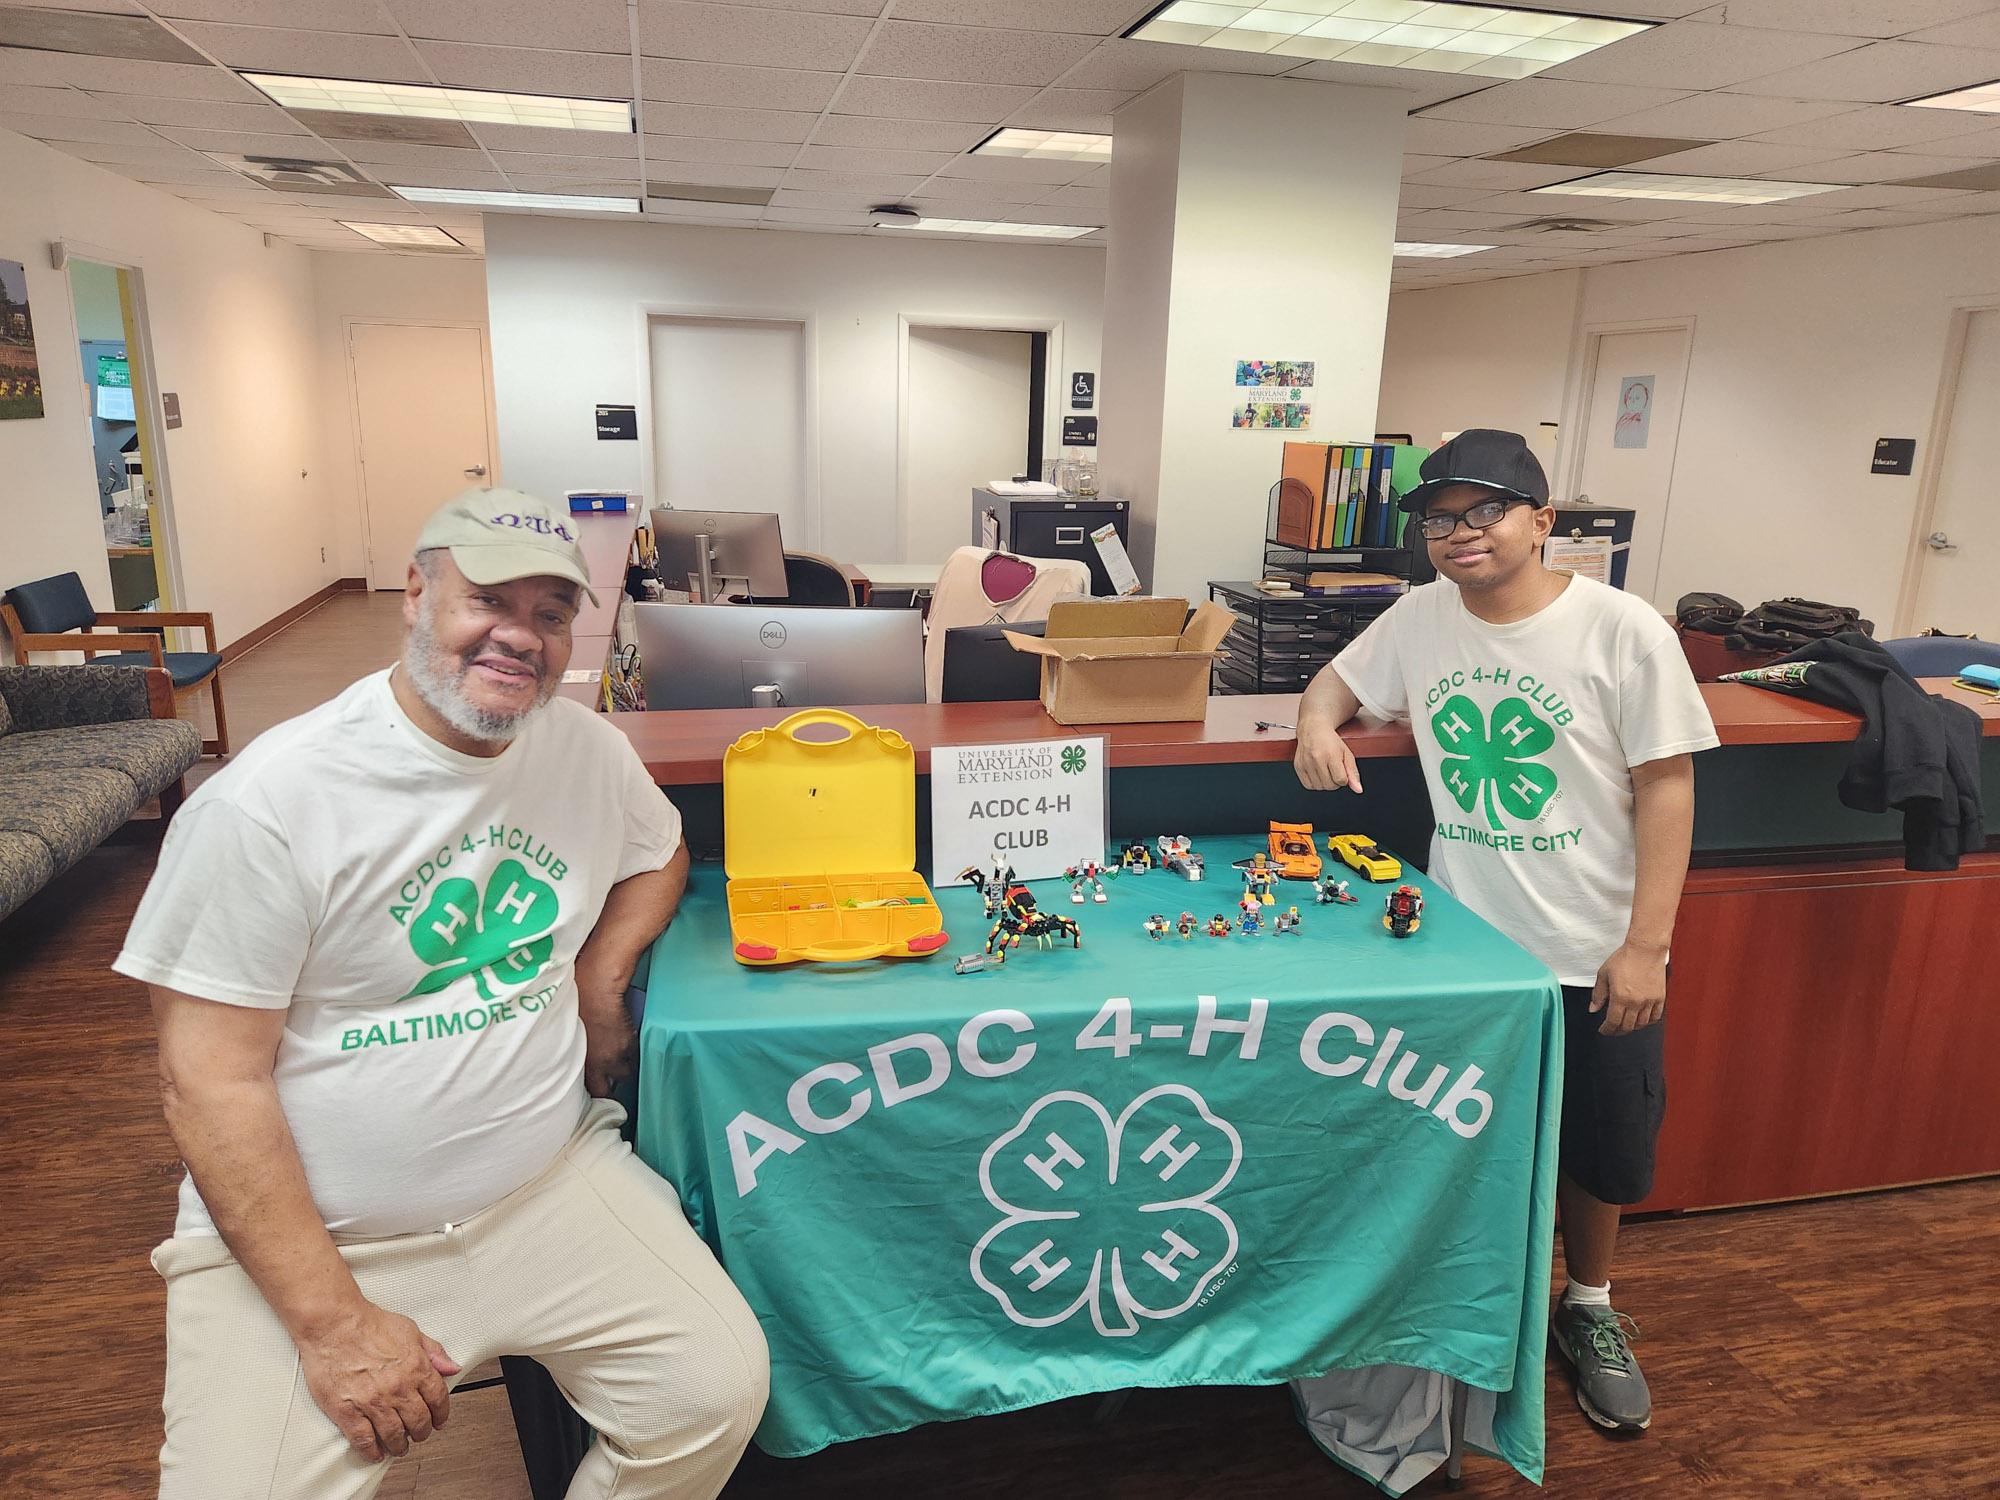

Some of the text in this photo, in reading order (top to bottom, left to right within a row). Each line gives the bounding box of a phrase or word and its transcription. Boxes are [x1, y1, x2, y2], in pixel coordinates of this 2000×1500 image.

[1874, 458, 1898, 466] Educator
[763, 631, 785, 639] DELL
[1472, 667, 1511, 686] 4-H
[1517, 675, 1575, 727] CLUB
[1440, 711, 1473, 744] H
[1500, 714, 1536, 748] H
[958, 748, 1034, 758] UNIVERSITY
[958, 754, 1053, 772] MARYLAND
[958, 768, 1052, 784] EXTENSION
[1449, 768, 1470, 797] H
[1508, 773, 1544, 806] H
[968, 794, 1071, 820] ACDC 4-H
[993, 828, 1049, 850] CLUB
[1436, 822, 1583, 852] ALTIMORE CITY
[388, 845, 453, 927] ACDC
[494, 880, 538, 925] H
[430, 902, 468, 946] H
[725, 995, 1494, 1198] ACDC 4-H Club
[1023, 1131, 1086, 1192] H
[1139, 1123, 1200, 1182] H
[1009, 1238, 1072, 1292] H
[1141, 1228, 1200, 1282] H
[1197, 1261, 1239, 1308] 18 USC 707
